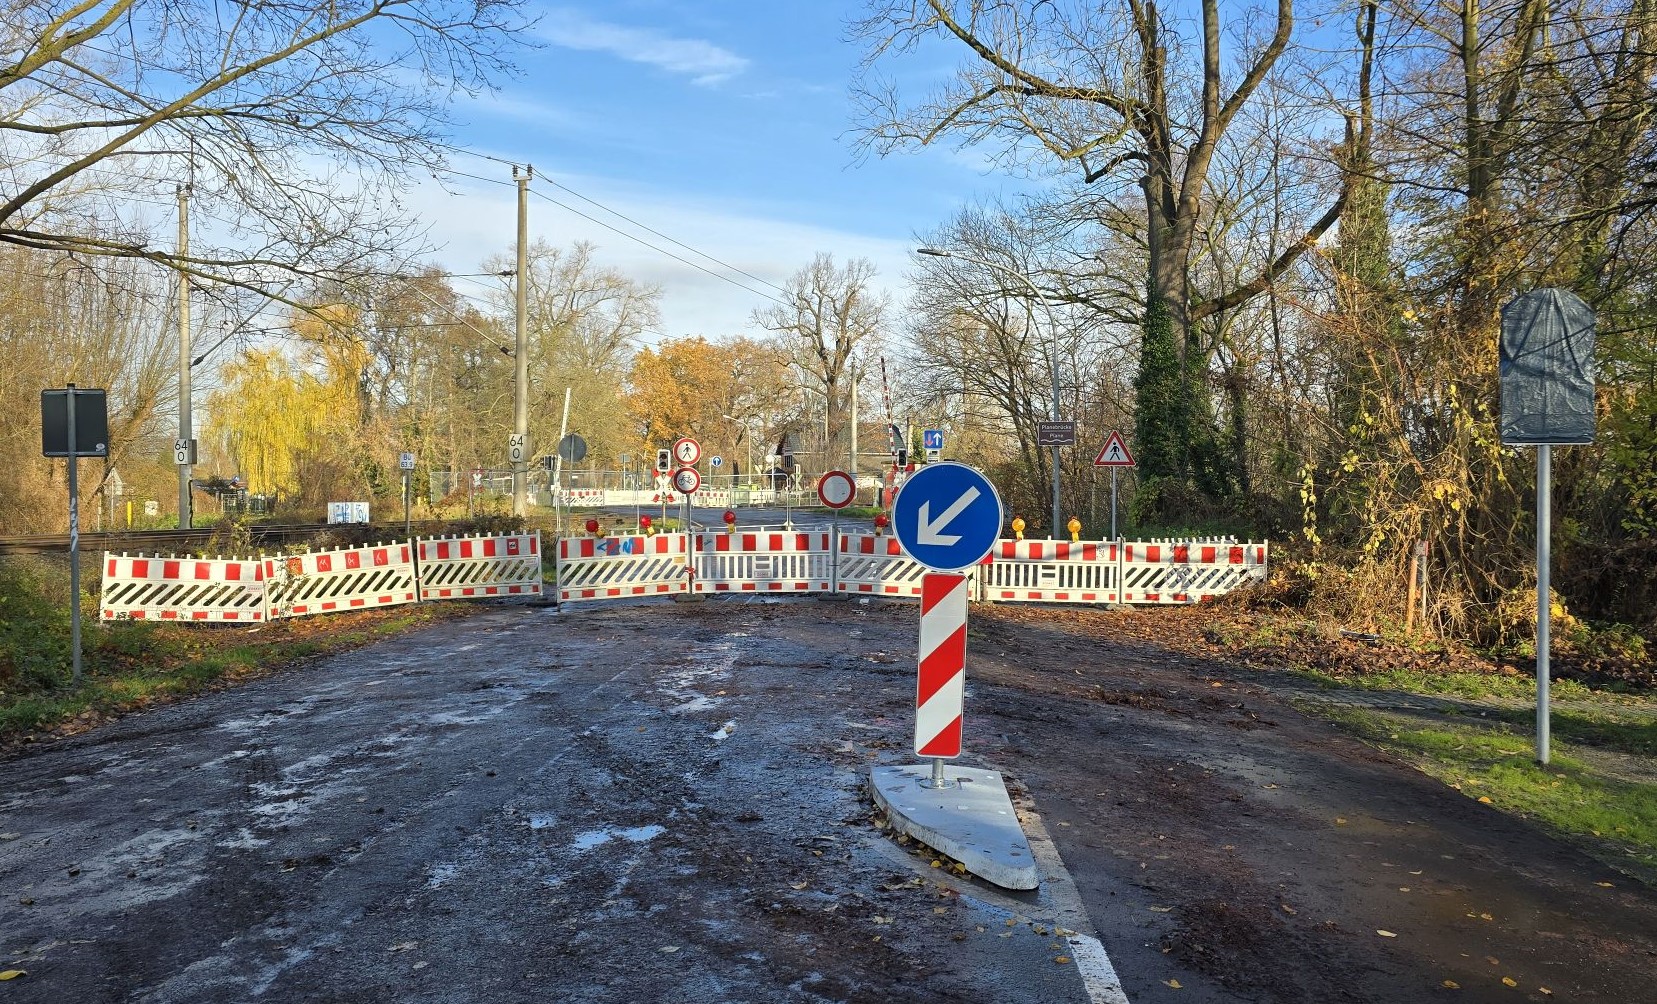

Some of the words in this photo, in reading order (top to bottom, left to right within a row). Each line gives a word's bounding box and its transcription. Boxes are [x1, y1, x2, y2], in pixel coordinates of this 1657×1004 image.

[175, 440, 188, 451] 64
[510, 436, 523, 447] 64
[178, 452, 184, 461] 0
[513, 448, 520, 459] 0
